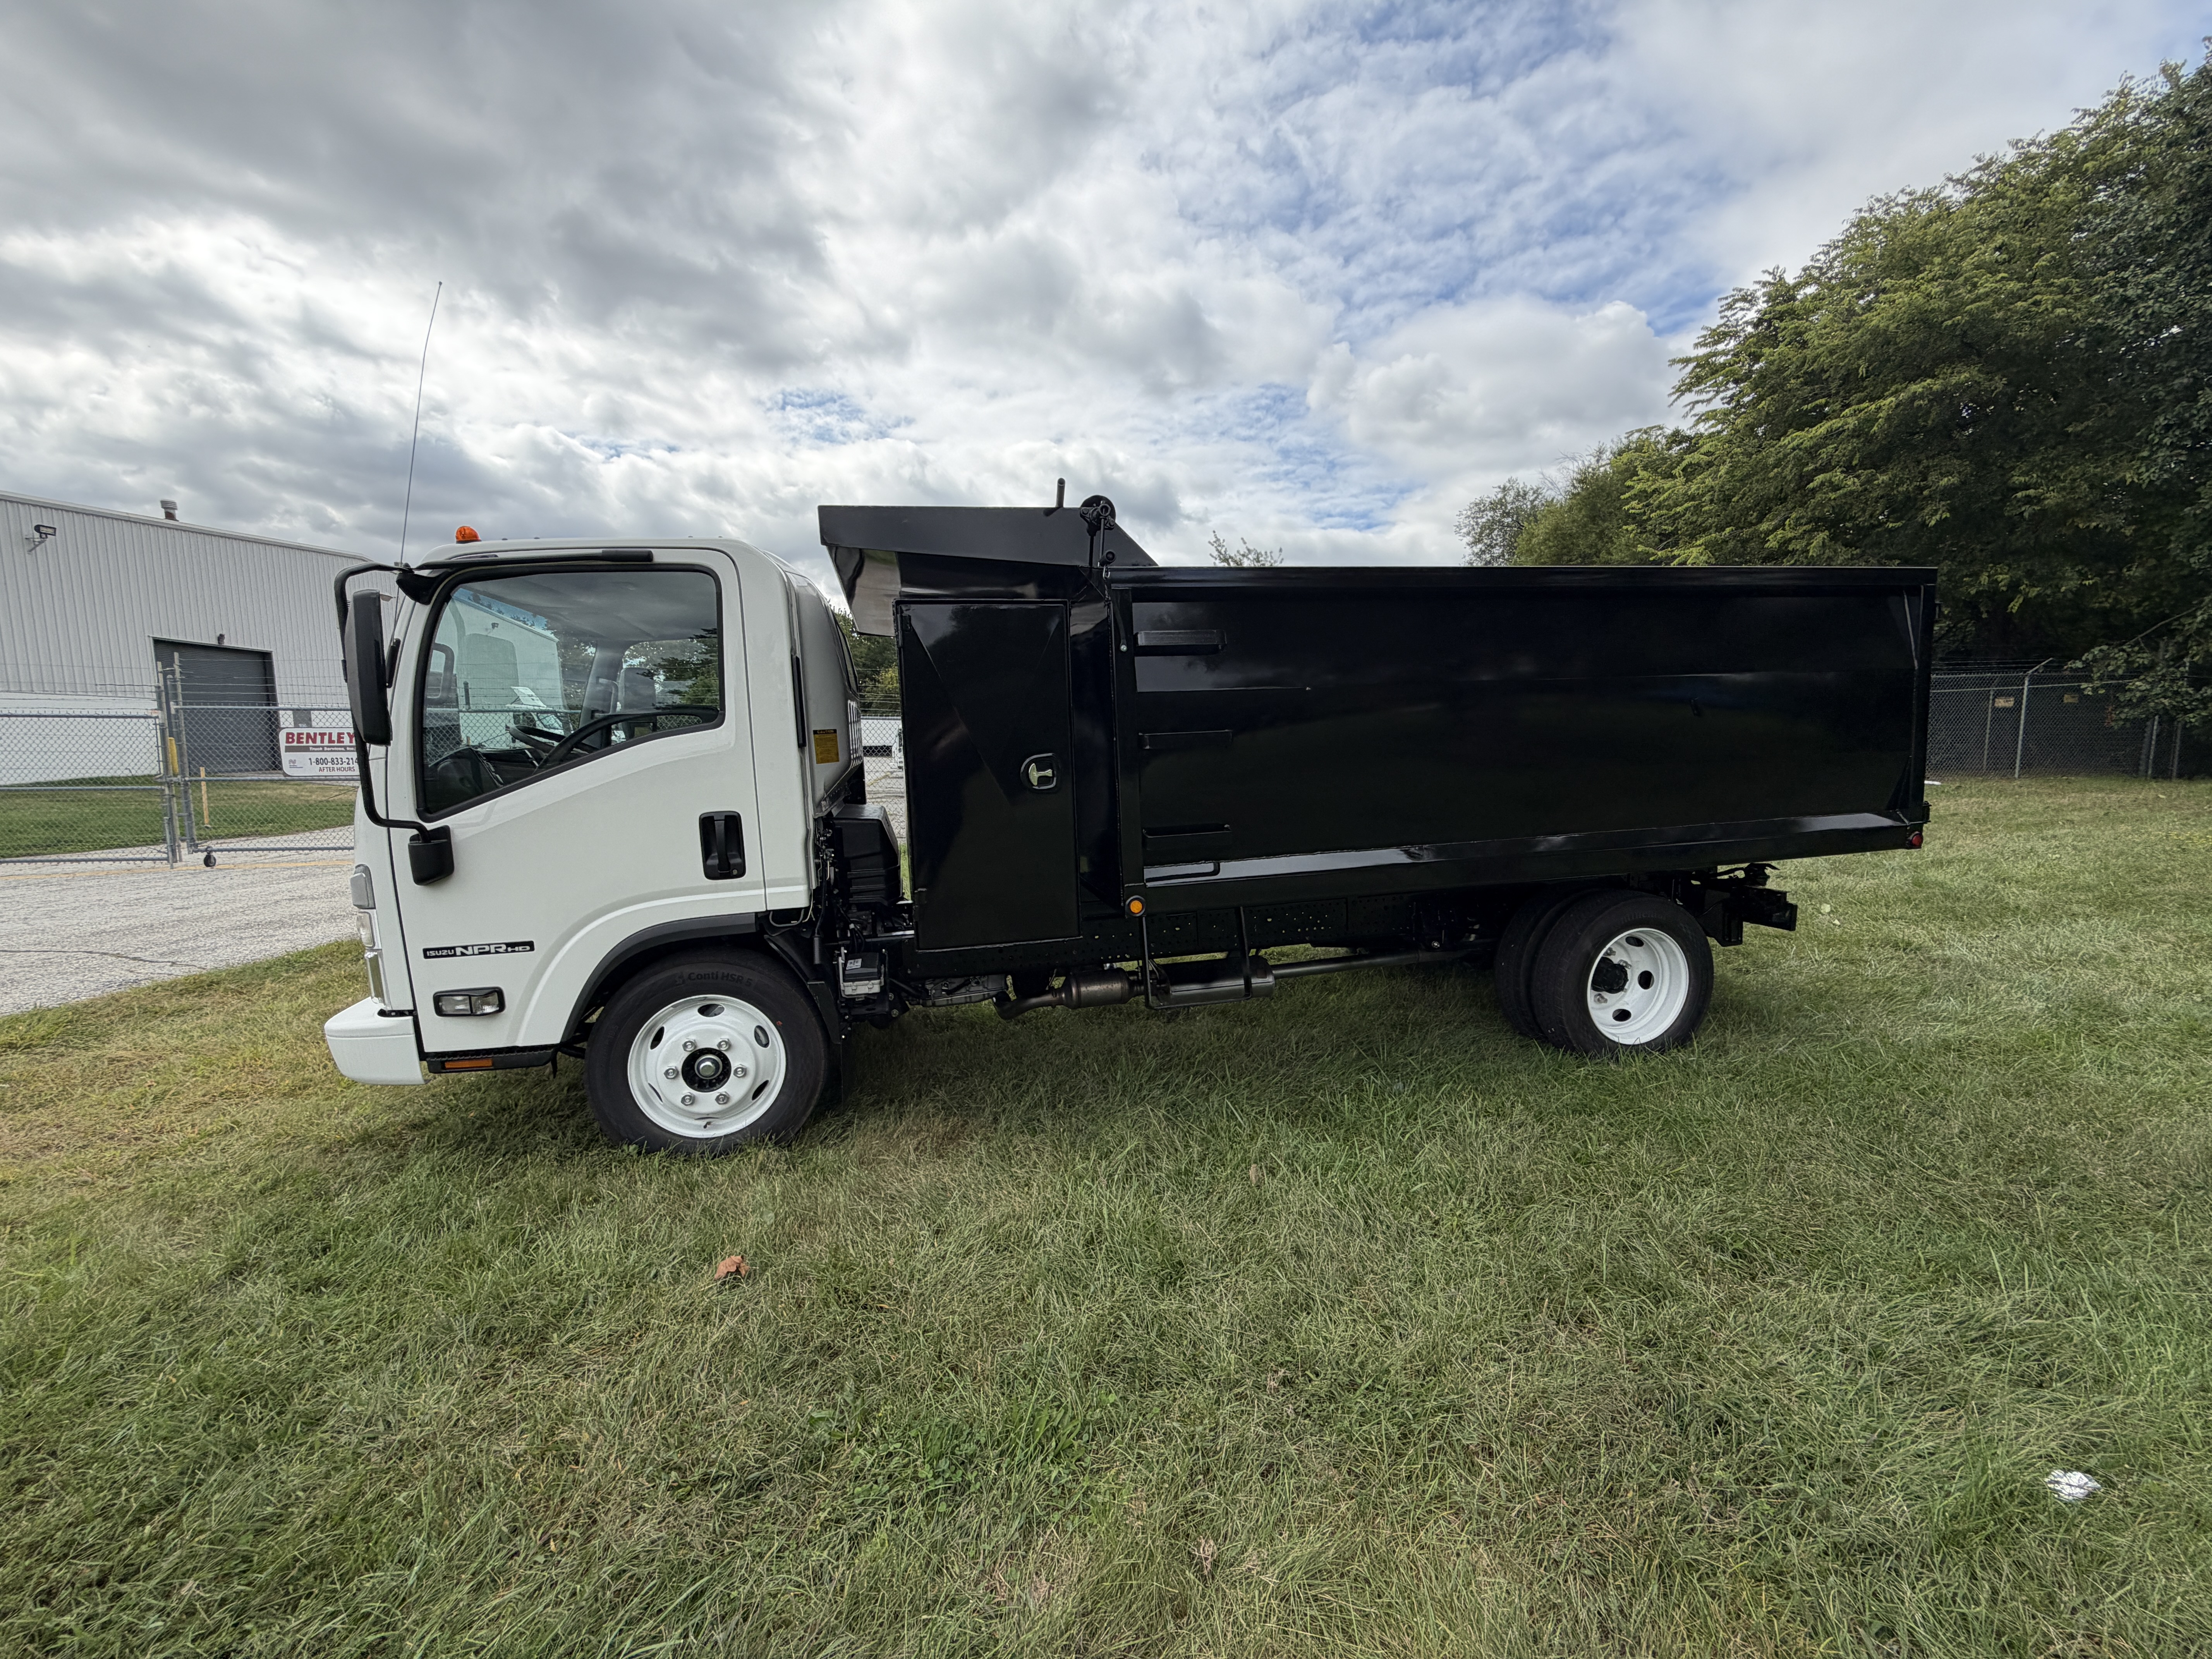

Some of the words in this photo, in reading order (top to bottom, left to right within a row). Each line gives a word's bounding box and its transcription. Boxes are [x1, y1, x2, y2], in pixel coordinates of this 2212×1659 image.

[285, 732, 355, 744] BENTLEY
[455, 944, 506, 955] NPR
[688, 971, 718, 981] Conti
[721, 972, 744, 984] HSR
[745, 978, 753, 987] 5
